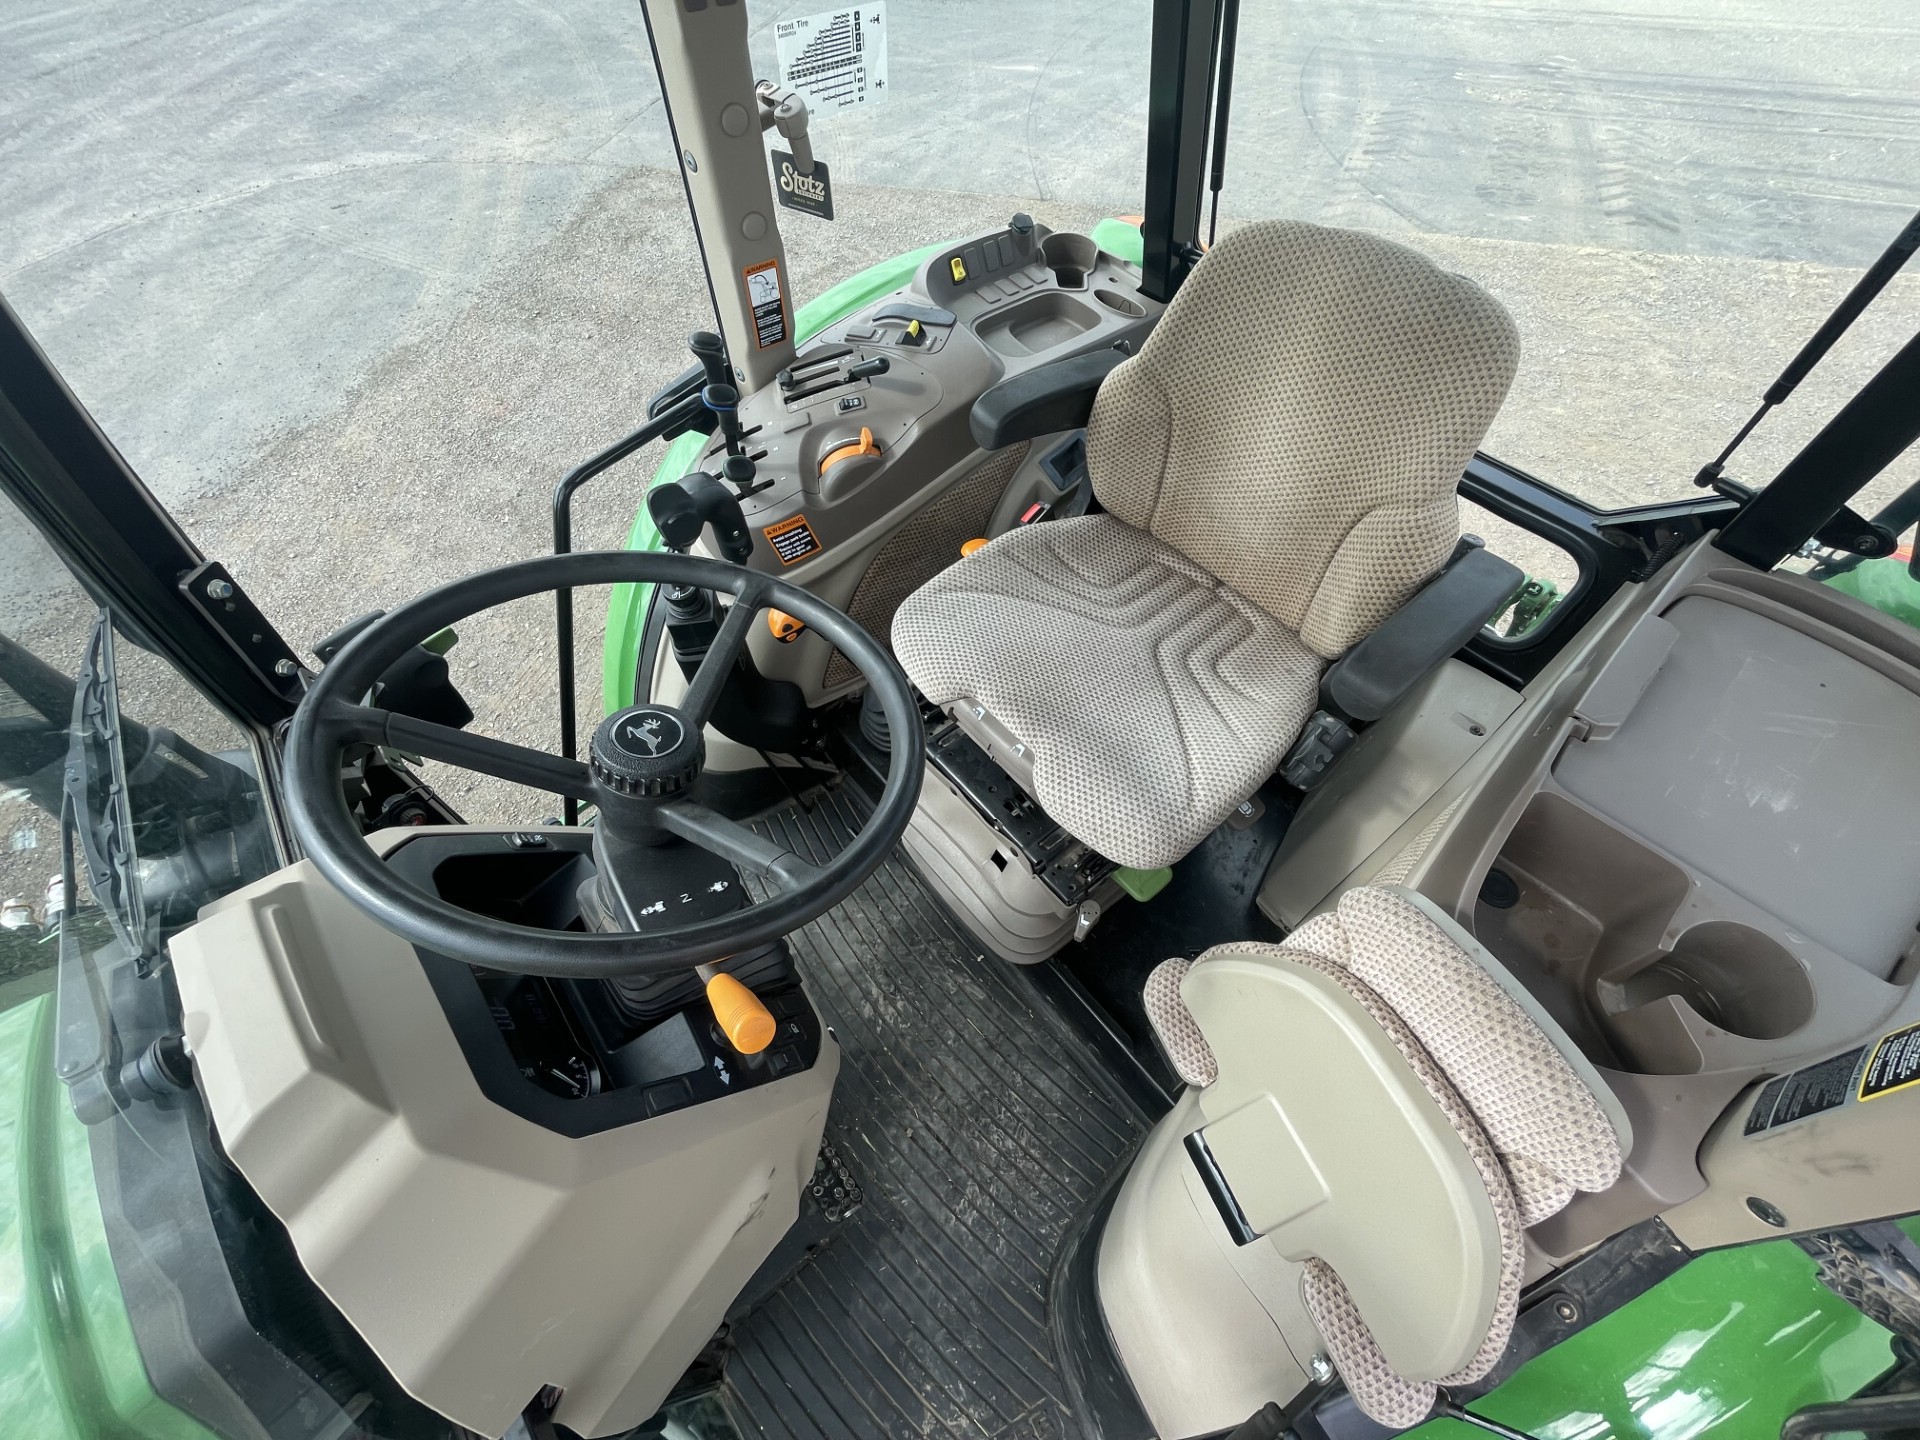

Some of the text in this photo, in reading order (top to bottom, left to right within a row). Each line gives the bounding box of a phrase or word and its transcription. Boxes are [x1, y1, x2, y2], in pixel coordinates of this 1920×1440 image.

[777, 19, 809, 33] Front Tire
[780, 162, 825, 195] Stotz
[750, 261, 775, 272] WARNING
[771, 517, 804, 533] WARNING
